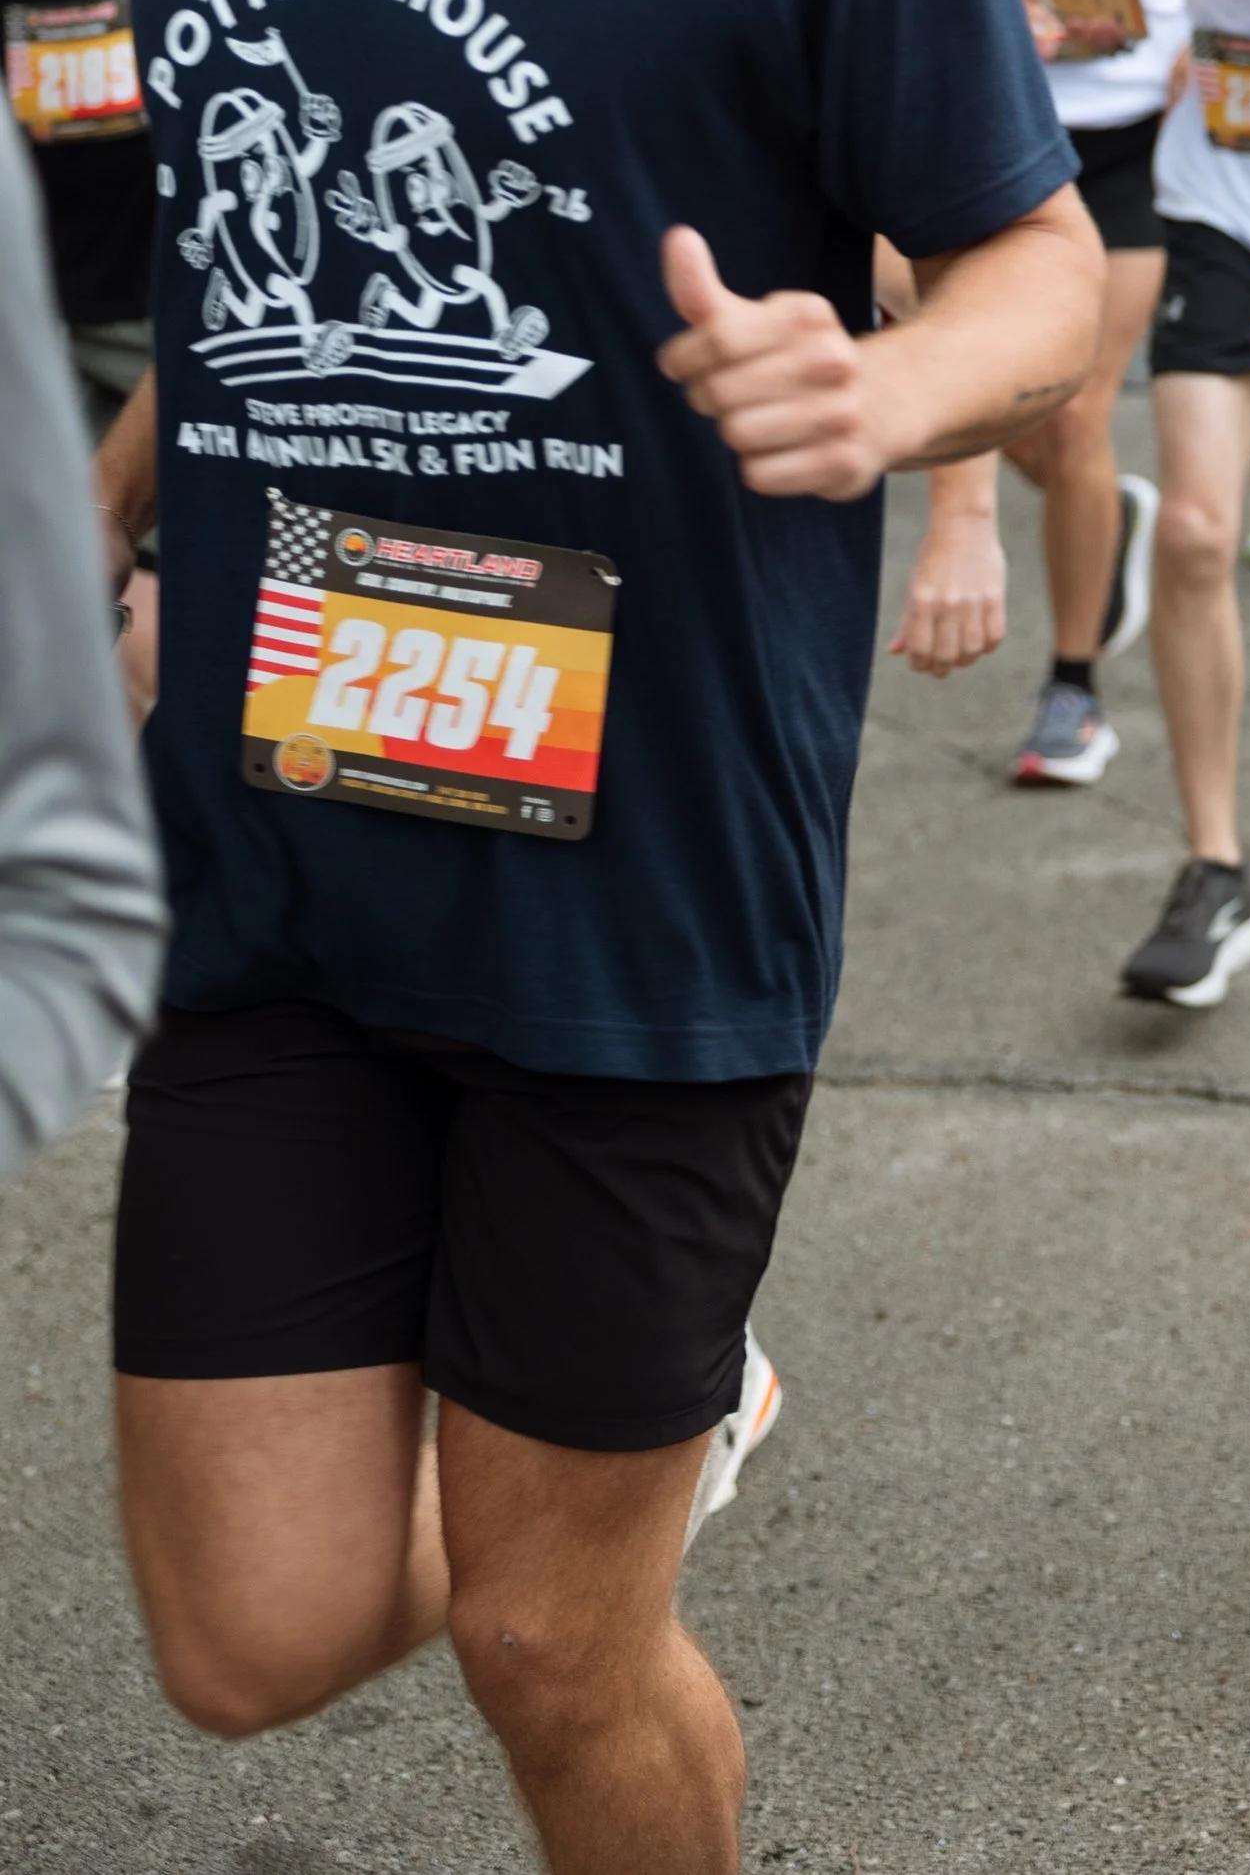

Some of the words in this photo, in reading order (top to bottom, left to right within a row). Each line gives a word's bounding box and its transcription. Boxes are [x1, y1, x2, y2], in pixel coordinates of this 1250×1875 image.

[407, 410, 511, 435] LEGACY
[177, 421, 240, 459] 4TH
[417, 444, 449, 476] &
[451, 439, 536, 476] FUN
[542, 437, 624, 478] RUN
[374, 536, 544, 582] HEARTLAND
[305, 616, 561, 762] 2254
